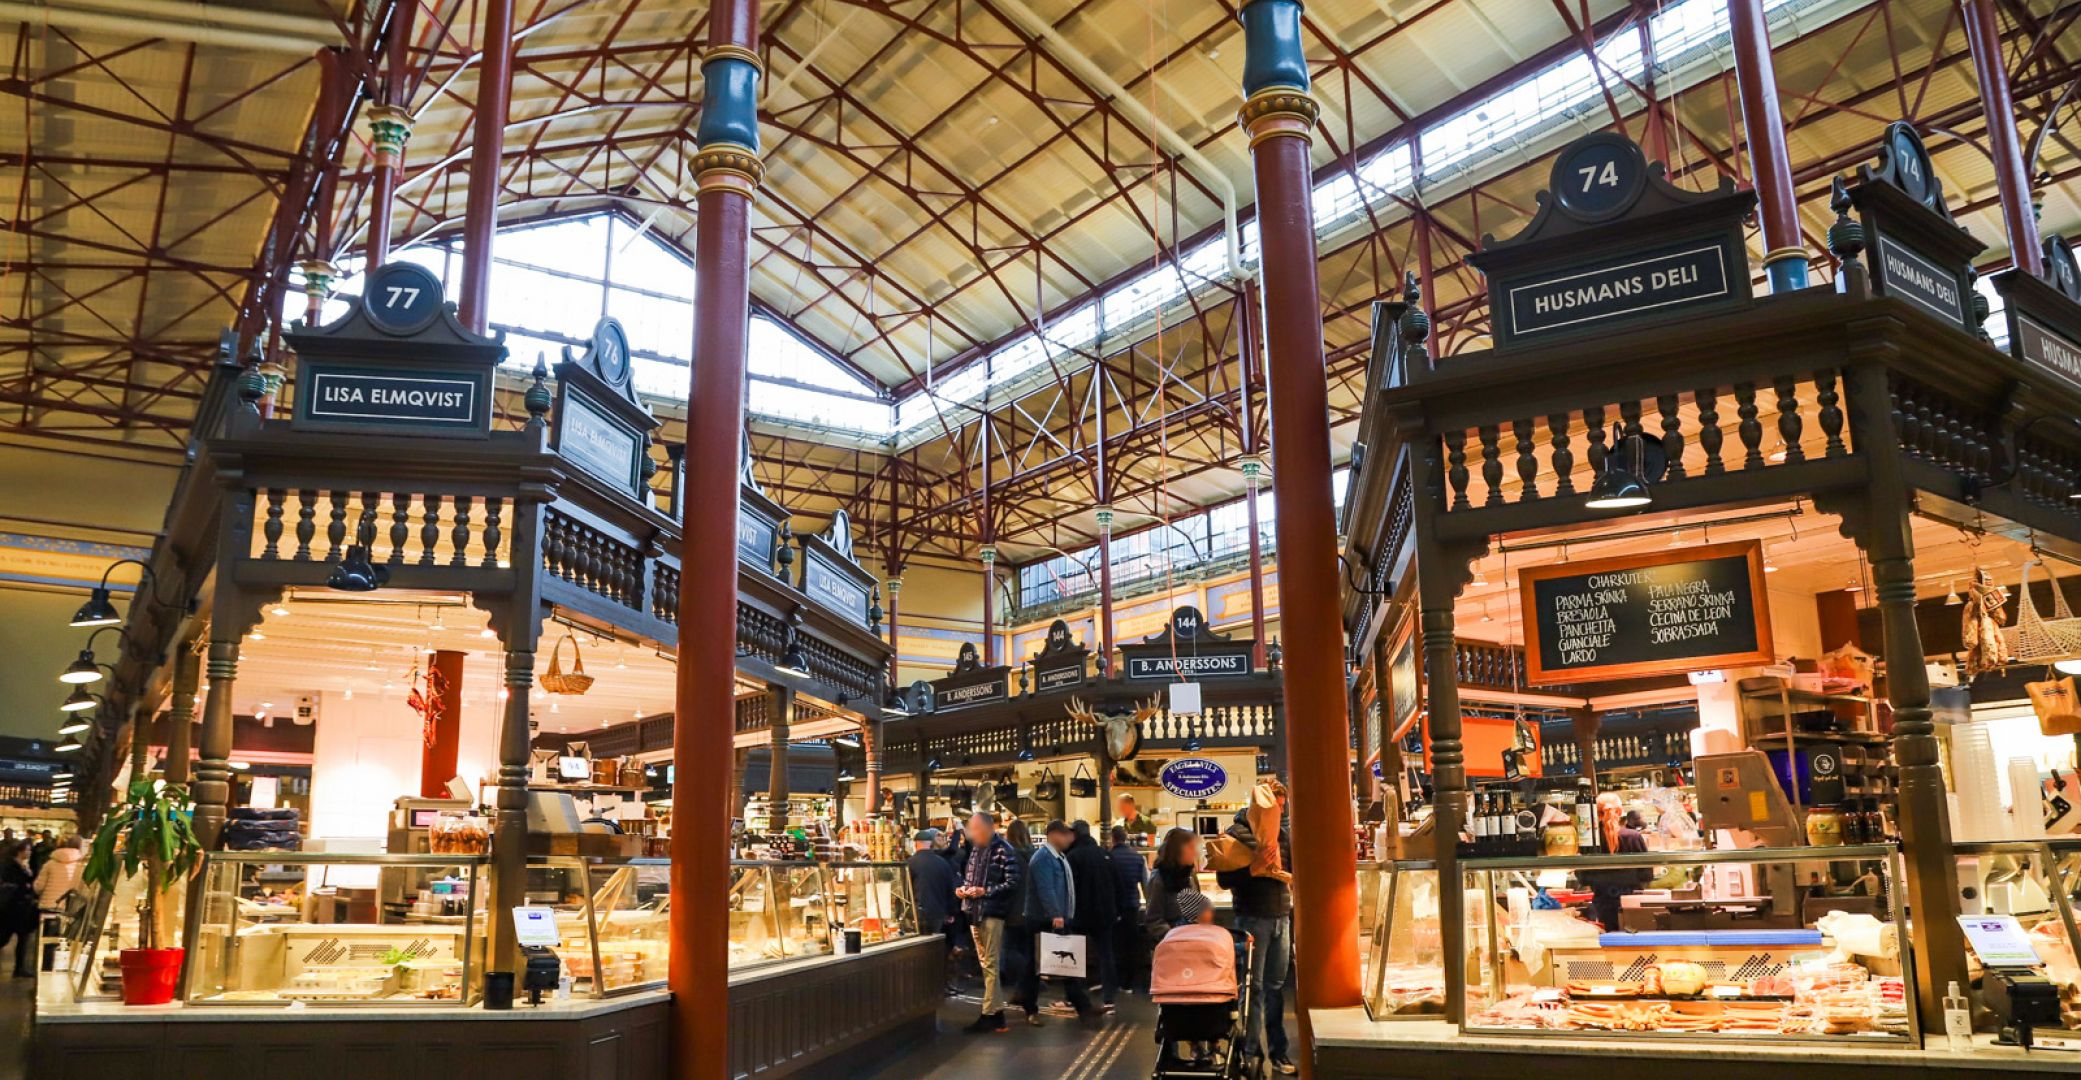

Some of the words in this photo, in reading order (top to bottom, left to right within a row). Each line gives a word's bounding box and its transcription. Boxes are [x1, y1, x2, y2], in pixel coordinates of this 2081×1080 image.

[1578, 161, 1619, 193] 74
[1901, 150, 1920, 182] 74
[1886, 253, 1935, 295] HUSMANS
[1936, 282, 1957, 307] DELI
[2059, 258, 2073, 284] 73
[386, 286, 420, 309] 77
[1535, 276, 1644, 314] HUSMANS
[1651, 264, 1698, 290] DELI
[605, 338, 619, 366] 76
[2041, 336, 2081, 378] HUSMA
[325, 386, 364, 403] LISA
[371, 388, 464, 407] ELMQVIST
[1676, 579, 1710, 596] NEGRA
[1556, 593, 1594, 611] PARMA
[1594, 589, 1627, 606] SKINKA
[1647, 595, 1697, 613] SERRANO
[1698, 590, 1736, 608] SKINKA
[1177, 617, 1197, 628] 144
[1556, 605, 1609, 624] BRESAOLA
[1649, 609, 1687, 627] CECINA
[1688, 608, 1702, 622] DE
[1053, 630, 1065, 642] 144
[1559, 618, 1616, 638] PANCHETTA
[1651, 620, 1719, 644] SOBRASSADA
[1558, 634, 1611, 652] GUANCIALE
[1141, 661, 1152, 672] B.
[1155, 657, 1237, 671] ANDERSSONS
[1561, 648, 1597, 665] LARDO
